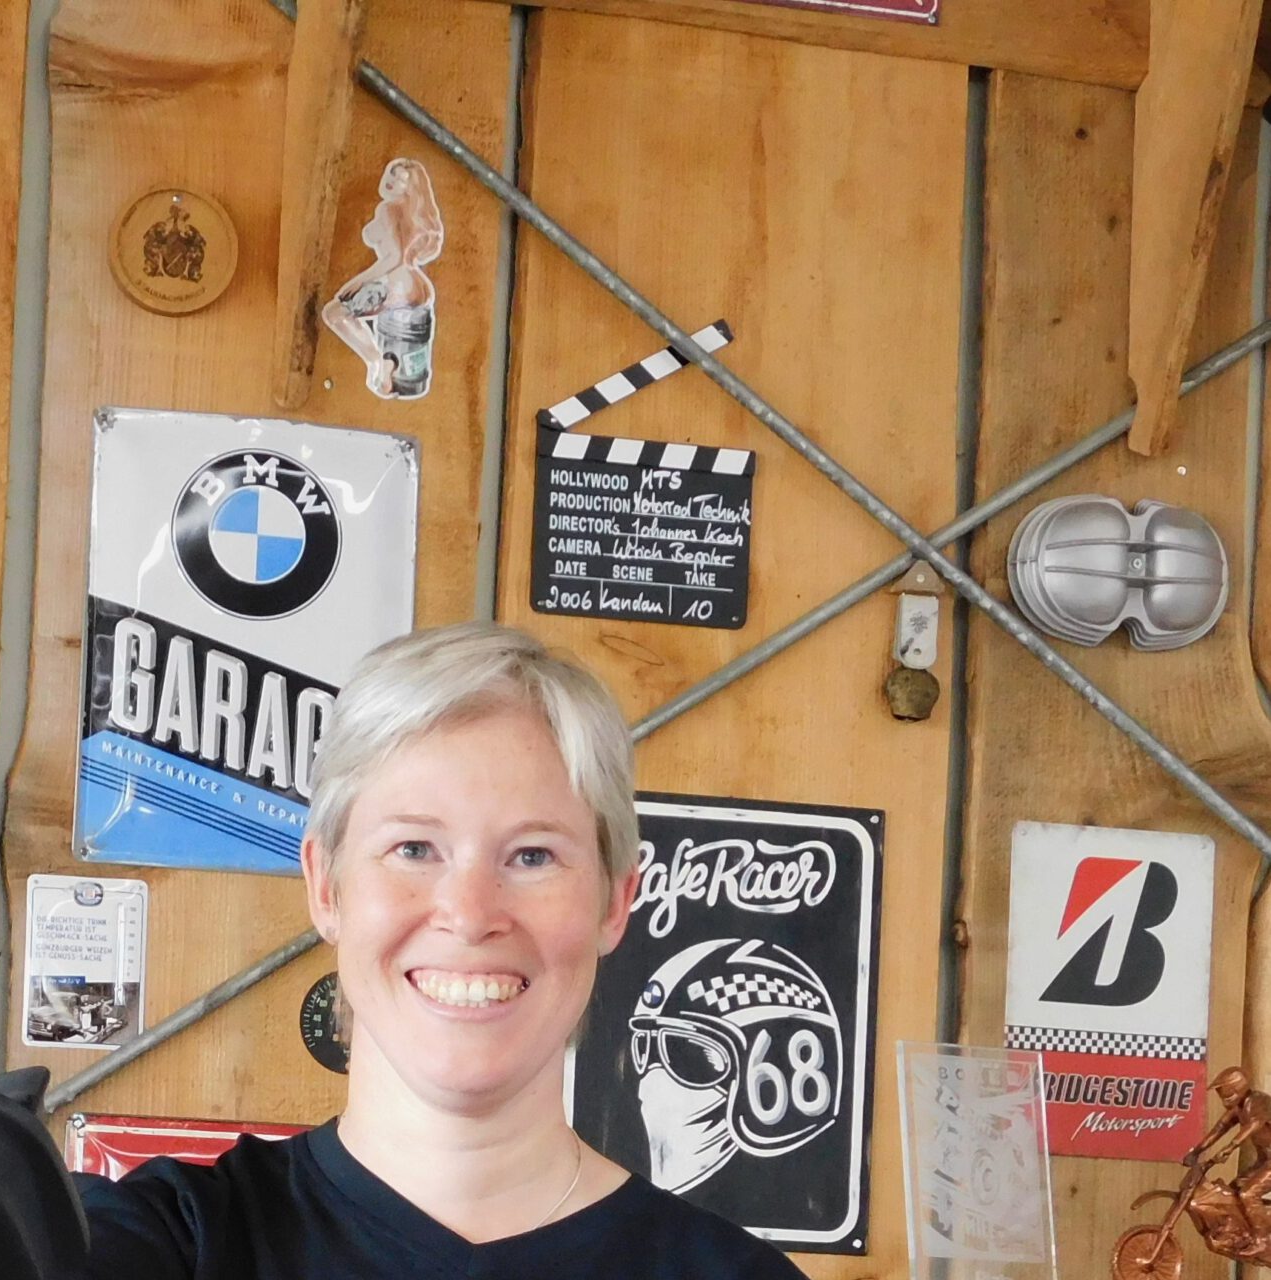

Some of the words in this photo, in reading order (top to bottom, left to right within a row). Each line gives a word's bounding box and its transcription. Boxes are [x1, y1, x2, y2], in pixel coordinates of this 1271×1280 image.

[191, 455, 331, 516] BMW
[551, 469, 629, 491] HOLLYWOOD
[550, 492, 631, 513] PRODUCTION
[548, 537, 601, 556] CAMERA
[555, 560, 587, 576] DATE
[613, 565, 654, 582] SCENE
[685, 571, 716, 587] TAKE
[546, 585, 592, 610] 2006
[682, 600, 713, 621] 10
[111, 616, 338, 798] GARAG
[102, 741, 219, 794] MAINTENANCE
[233, 792, 245, 804] &
[258, 802, 306, 827] REPAI
[684, 838, 836, 914] Racer
[746, 1029, 831, 1125] 68
[1042, 1071, 1194, 1112] RIDGESTONE
[1070, 1111, 1185, 1139] Motorsport
